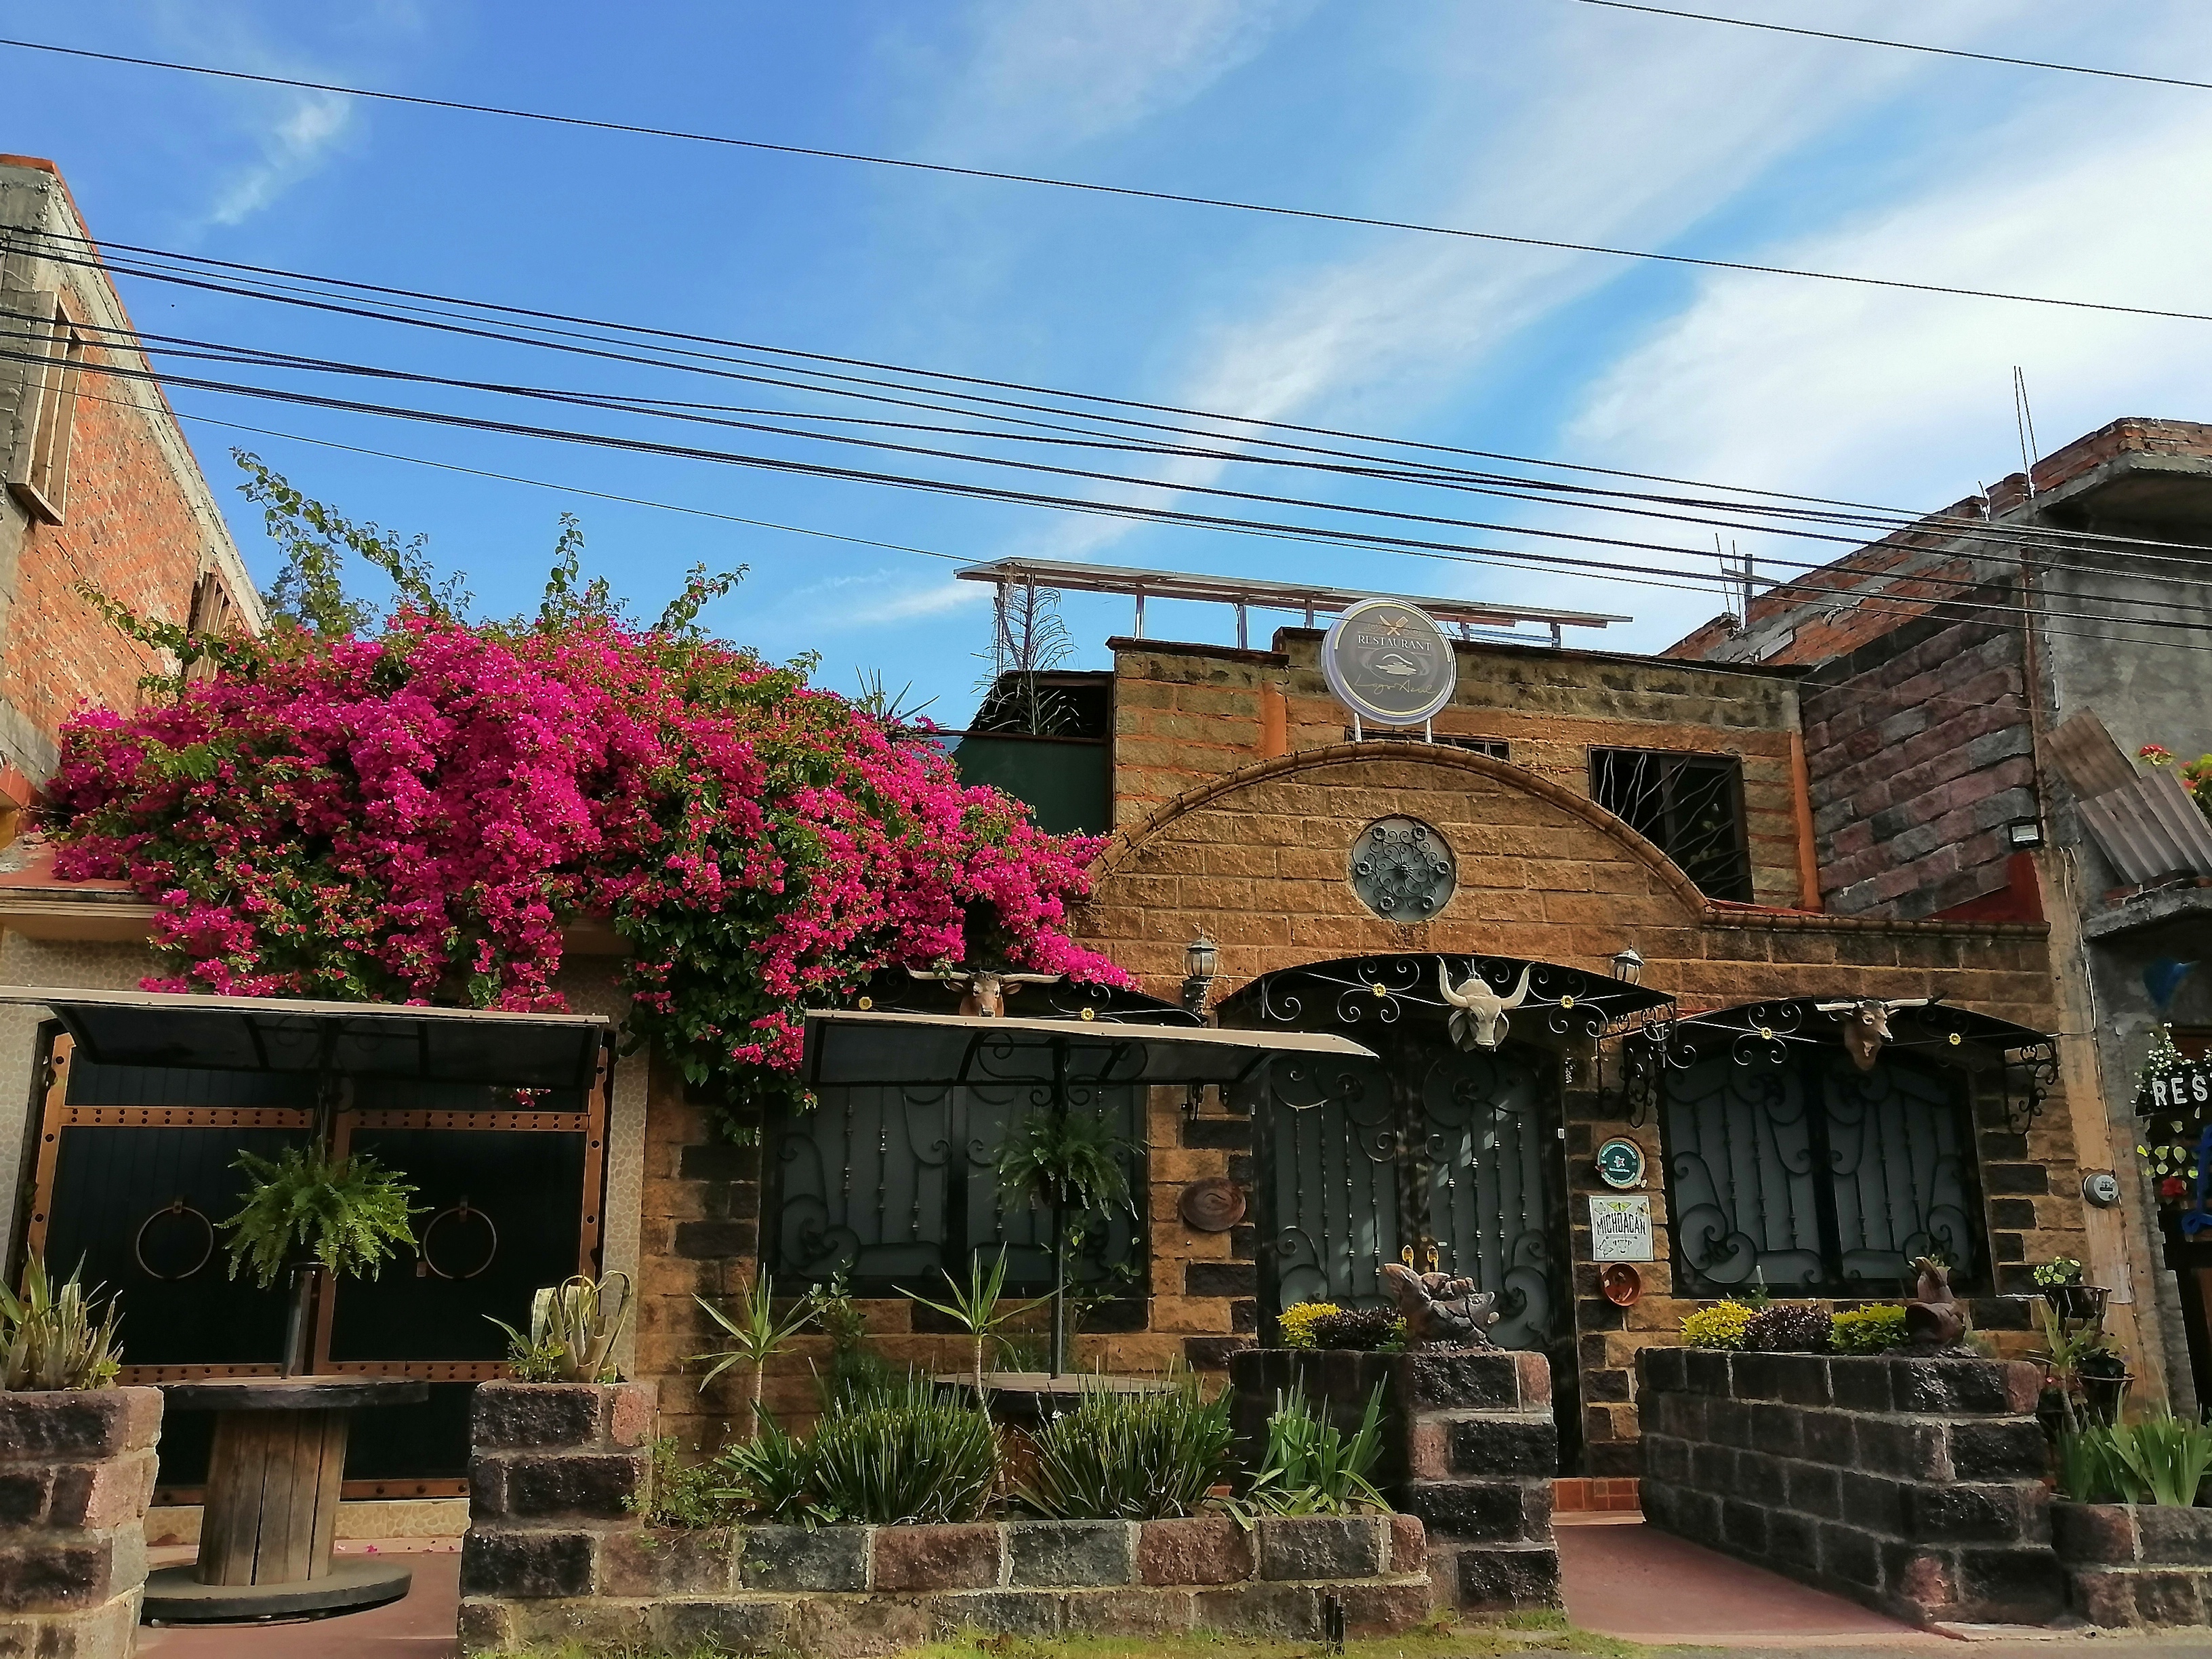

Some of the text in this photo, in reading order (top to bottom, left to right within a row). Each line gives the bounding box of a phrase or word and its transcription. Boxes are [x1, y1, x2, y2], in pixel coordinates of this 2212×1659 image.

[1358, 635, 1431, 651] RESTAURANT
[1355, 674, 1436, 695] Lago Azul
[2152, 1072, 2212, 1106] RES
[1597, 1212, 1645, 1235] MICHOACÁN
